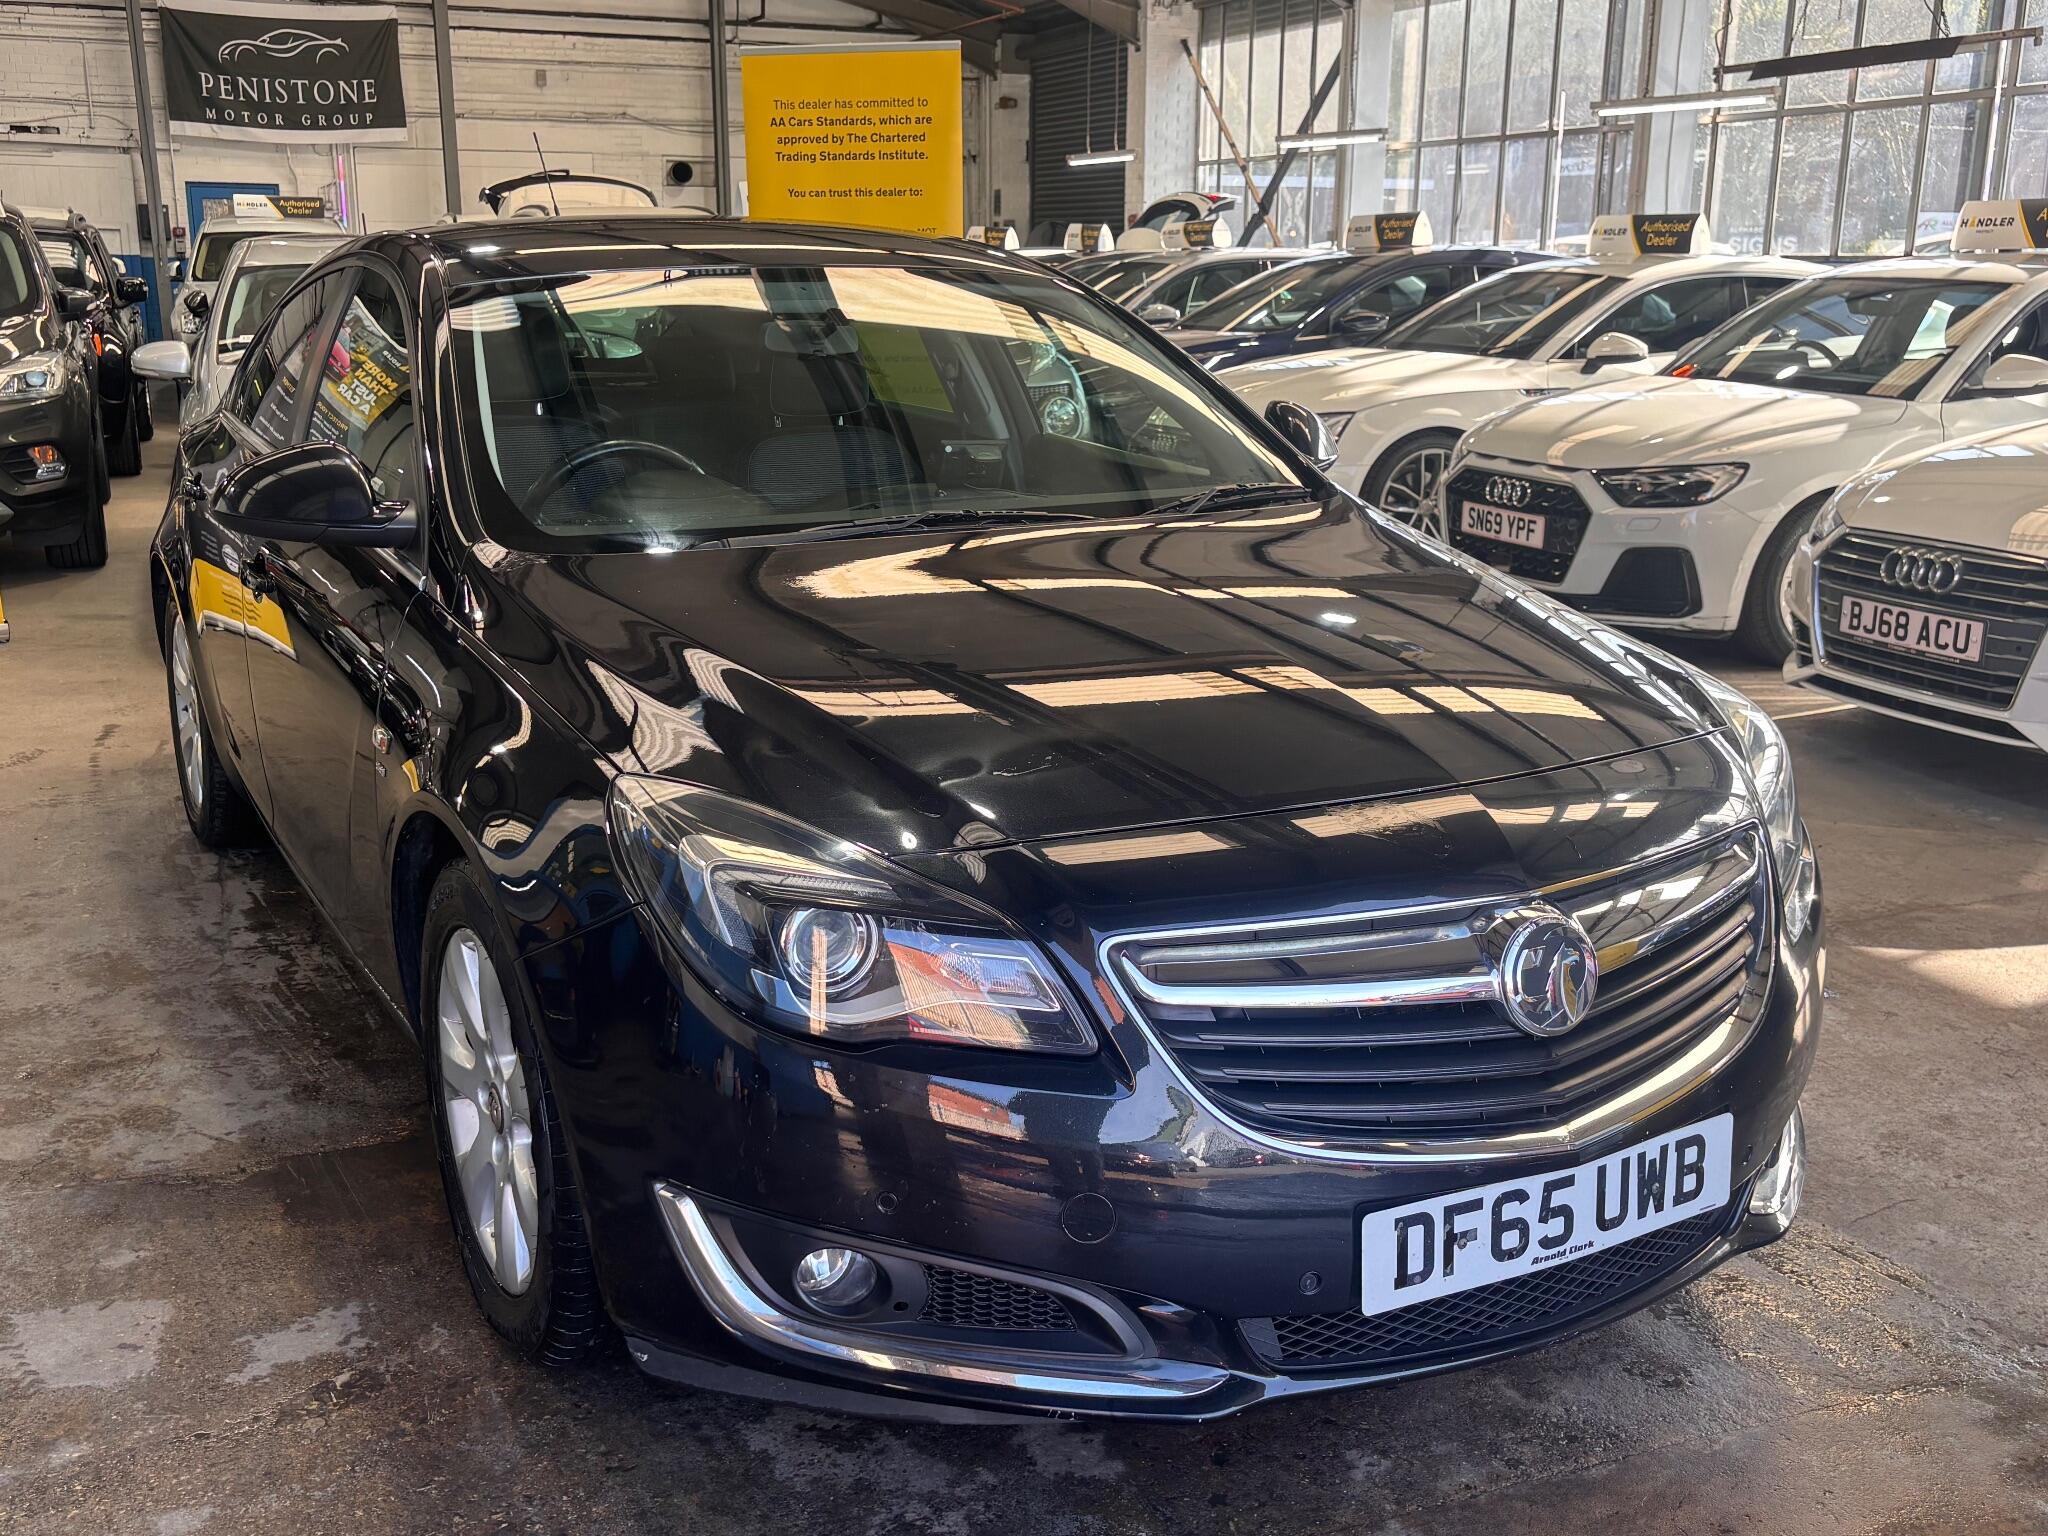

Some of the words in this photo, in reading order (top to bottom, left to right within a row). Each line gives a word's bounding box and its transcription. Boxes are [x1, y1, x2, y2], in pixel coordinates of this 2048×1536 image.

[199, 71, 377, 105] PENISTONE
[774, 99, 795, 110] This
[798, 99, 831, 110] dealer
[834, 98, 853, 109] has
[856, 97, 914, 109] committed
[917, 97, 928, 107] to
[205, 107, 284, 126] MOTOR
[301, 112, 374, 127] GROUP
[770, 117, 786, 127] AA
[788, 117, 814, 127] Cars
[816, 115, 876, 127] Standards,
[879, 115, 912, 125] which
[914, 116, 932, 125] are
[777, 133, 829, 146] approved
[831, 133, 844, 145] by
[847, 133, 867, 143] The
[870, 132, 926, 143] Chartered
[775, 151, 816, 163] Trading
[819, 150, 876, 161] Standards
[878, 149, 929, 161] Institute.
[788, 188, 806, 198] You
[808, 189, 826, 198] can
[828, 188, 852, 197] trust
[854, 188, 873, 197] this
[875, 187, 907, 197] dealer
[909, 188, 923, 197] to:
[280, 199, 320, 209] Authorised
[287, 206, 313, 215] Dealer
[1640, 219, 1692, 232] Authorised
[1960, 215, 2015, 229] HANDLER
[1646, 233, 1679, 247] Dealer
[1468, 506, 1503, 535] SN69
[1507, 514, 1537, 542] YPF
[1848, 601, 1910, 642] BJ68
[1916, 615, 1972, 654] ACU
[1393, 1173, 1577, 1291] DF65
[1594, 1133, 1707, 1233] UWB
[1530, 1248, 1568, 1266] Arnold
[1568, 1239, 1595, 1255] Clark
